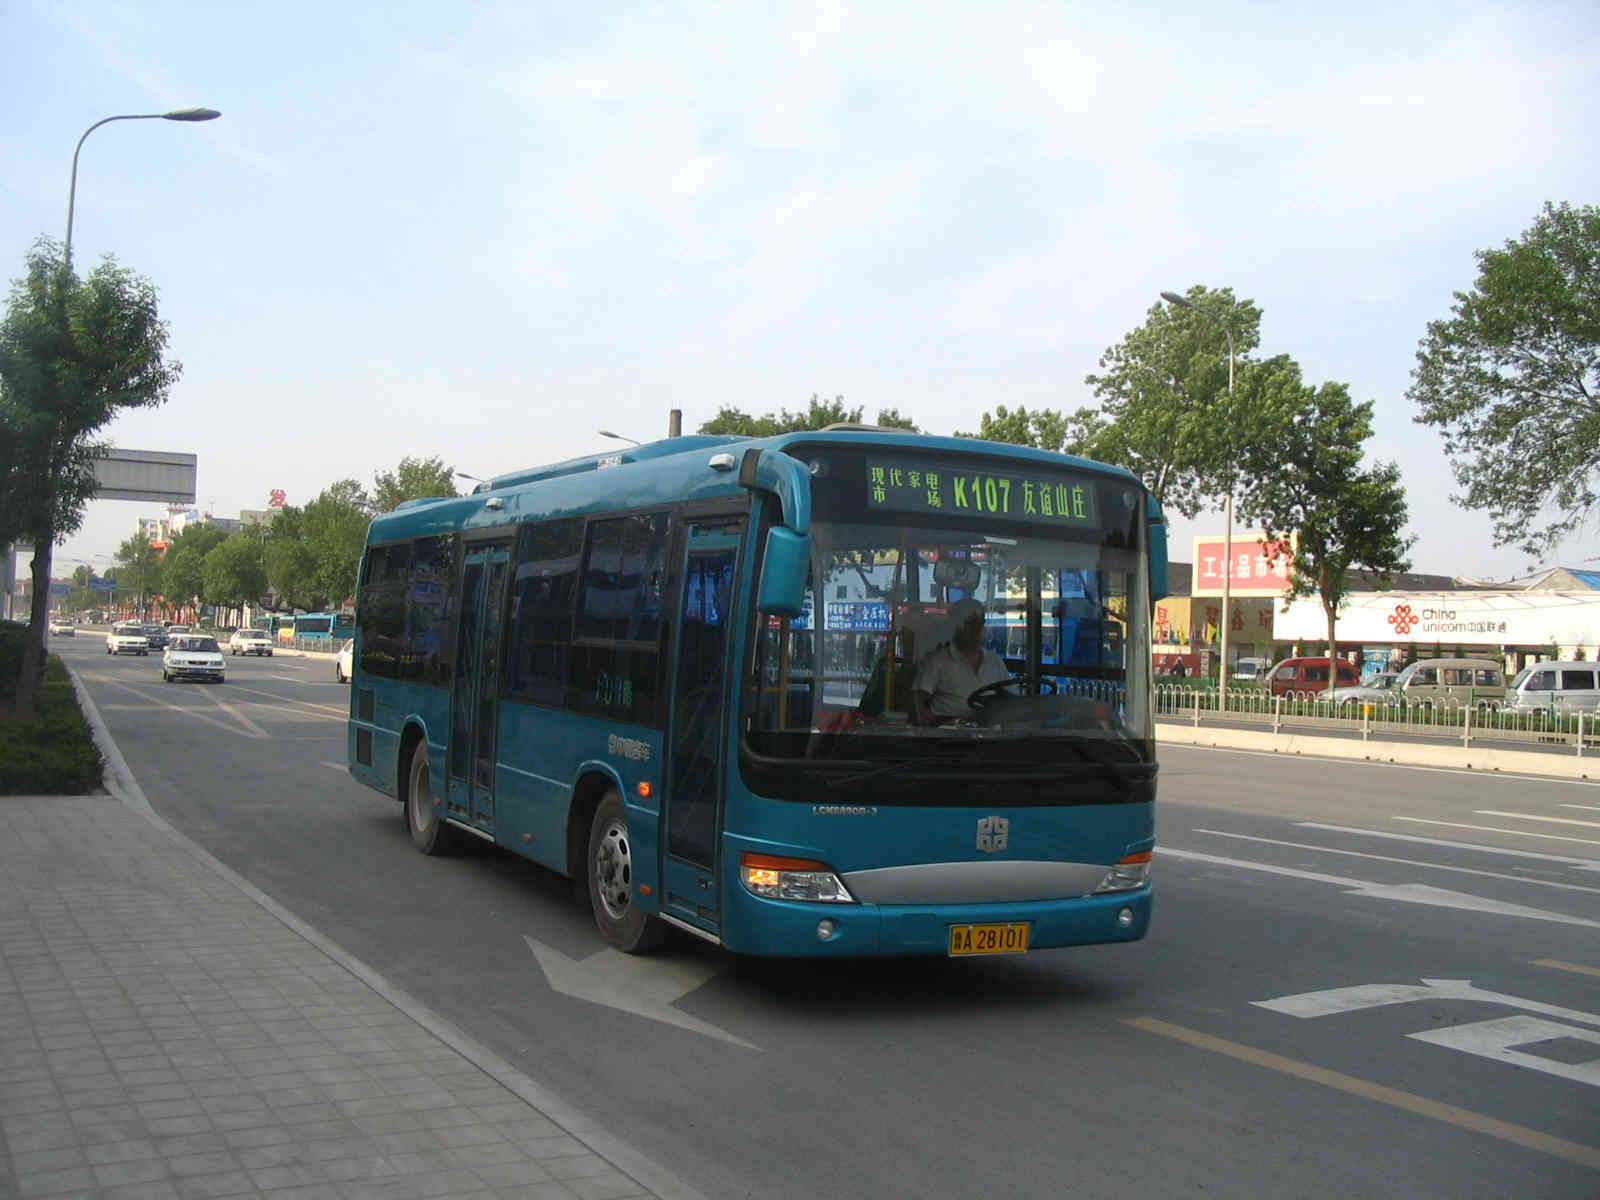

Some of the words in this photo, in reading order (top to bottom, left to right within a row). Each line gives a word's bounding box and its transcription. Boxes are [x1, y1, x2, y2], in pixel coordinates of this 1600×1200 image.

[872, 467, 940, 489] 现代家电
[953, 477, 1010, 512] K107
[1203, 553, 1288, 579] 工业品市场
[1422, 608, 1457, 621] China
